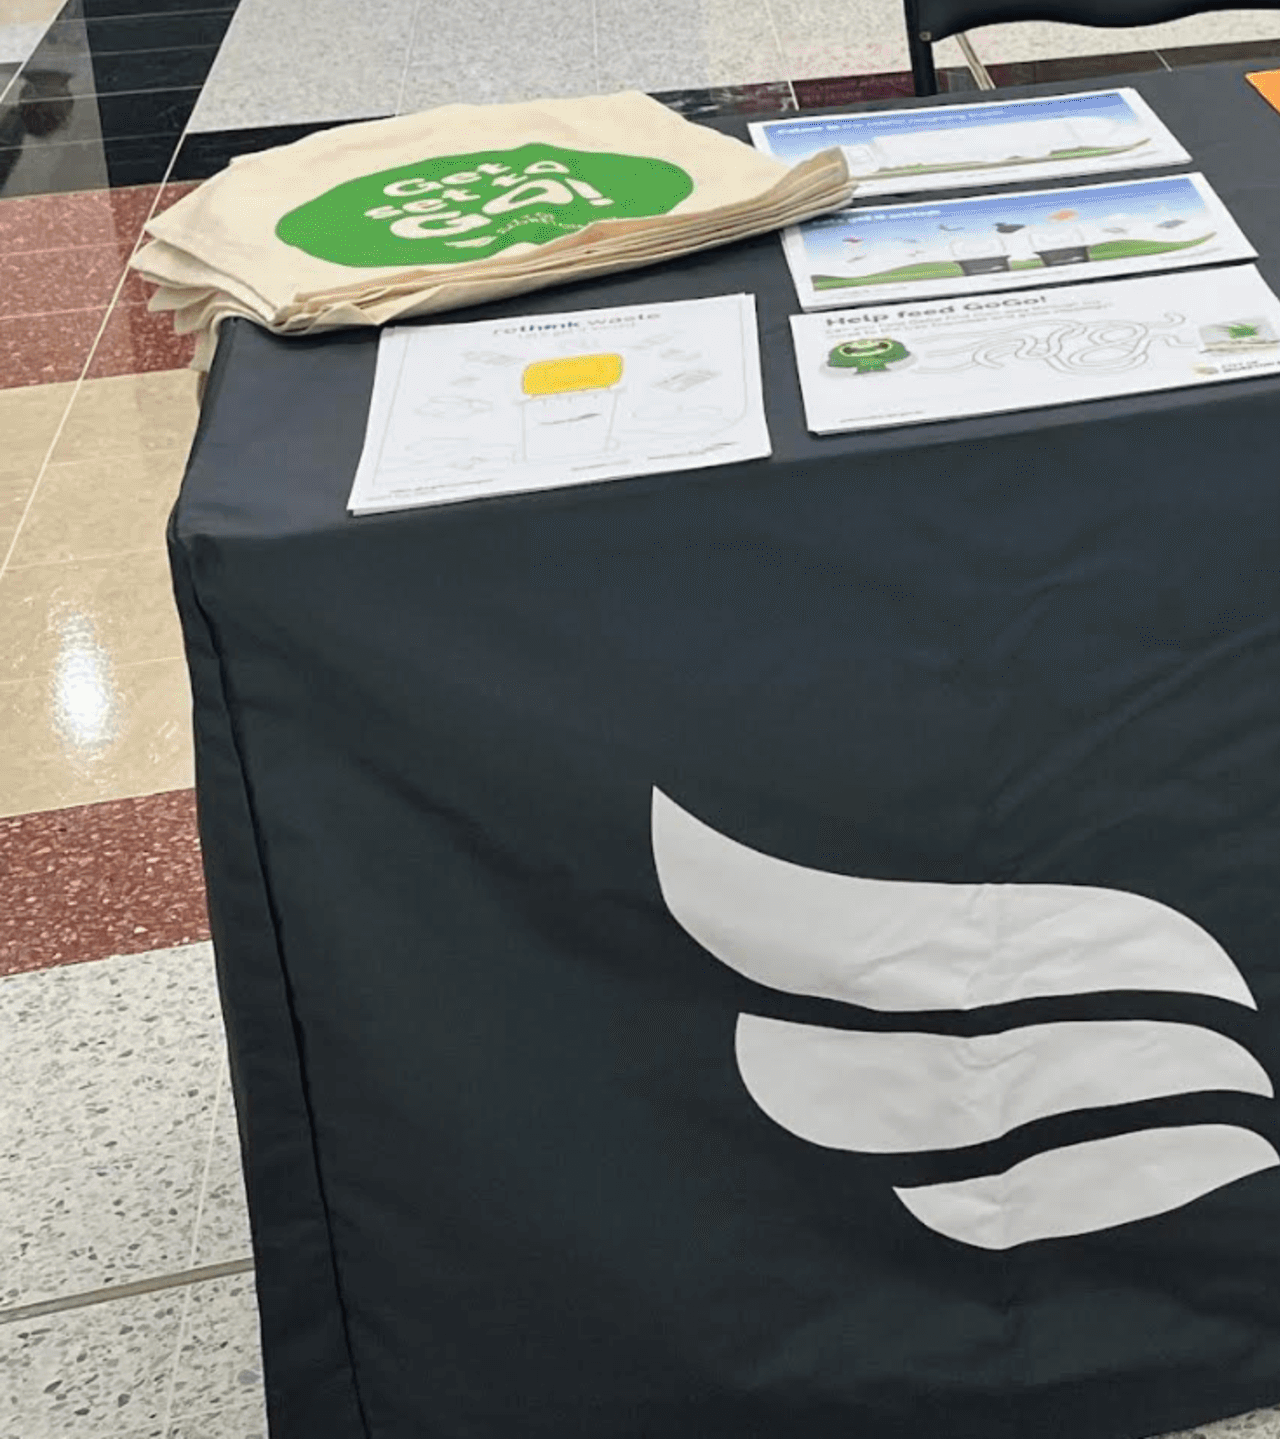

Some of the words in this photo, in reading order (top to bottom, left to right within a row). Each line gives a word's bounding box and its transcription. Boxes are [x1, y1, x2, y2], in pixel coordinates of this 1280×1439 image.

[383, 162, 512, 197] Get
[364, 188, 482, 219] set
[389, 177, 615, 239] GO!
[825, 312, 889, 327] Help
[898, 304, 956, 319] feed
[962, 295, 1047, 312] GoGo!
